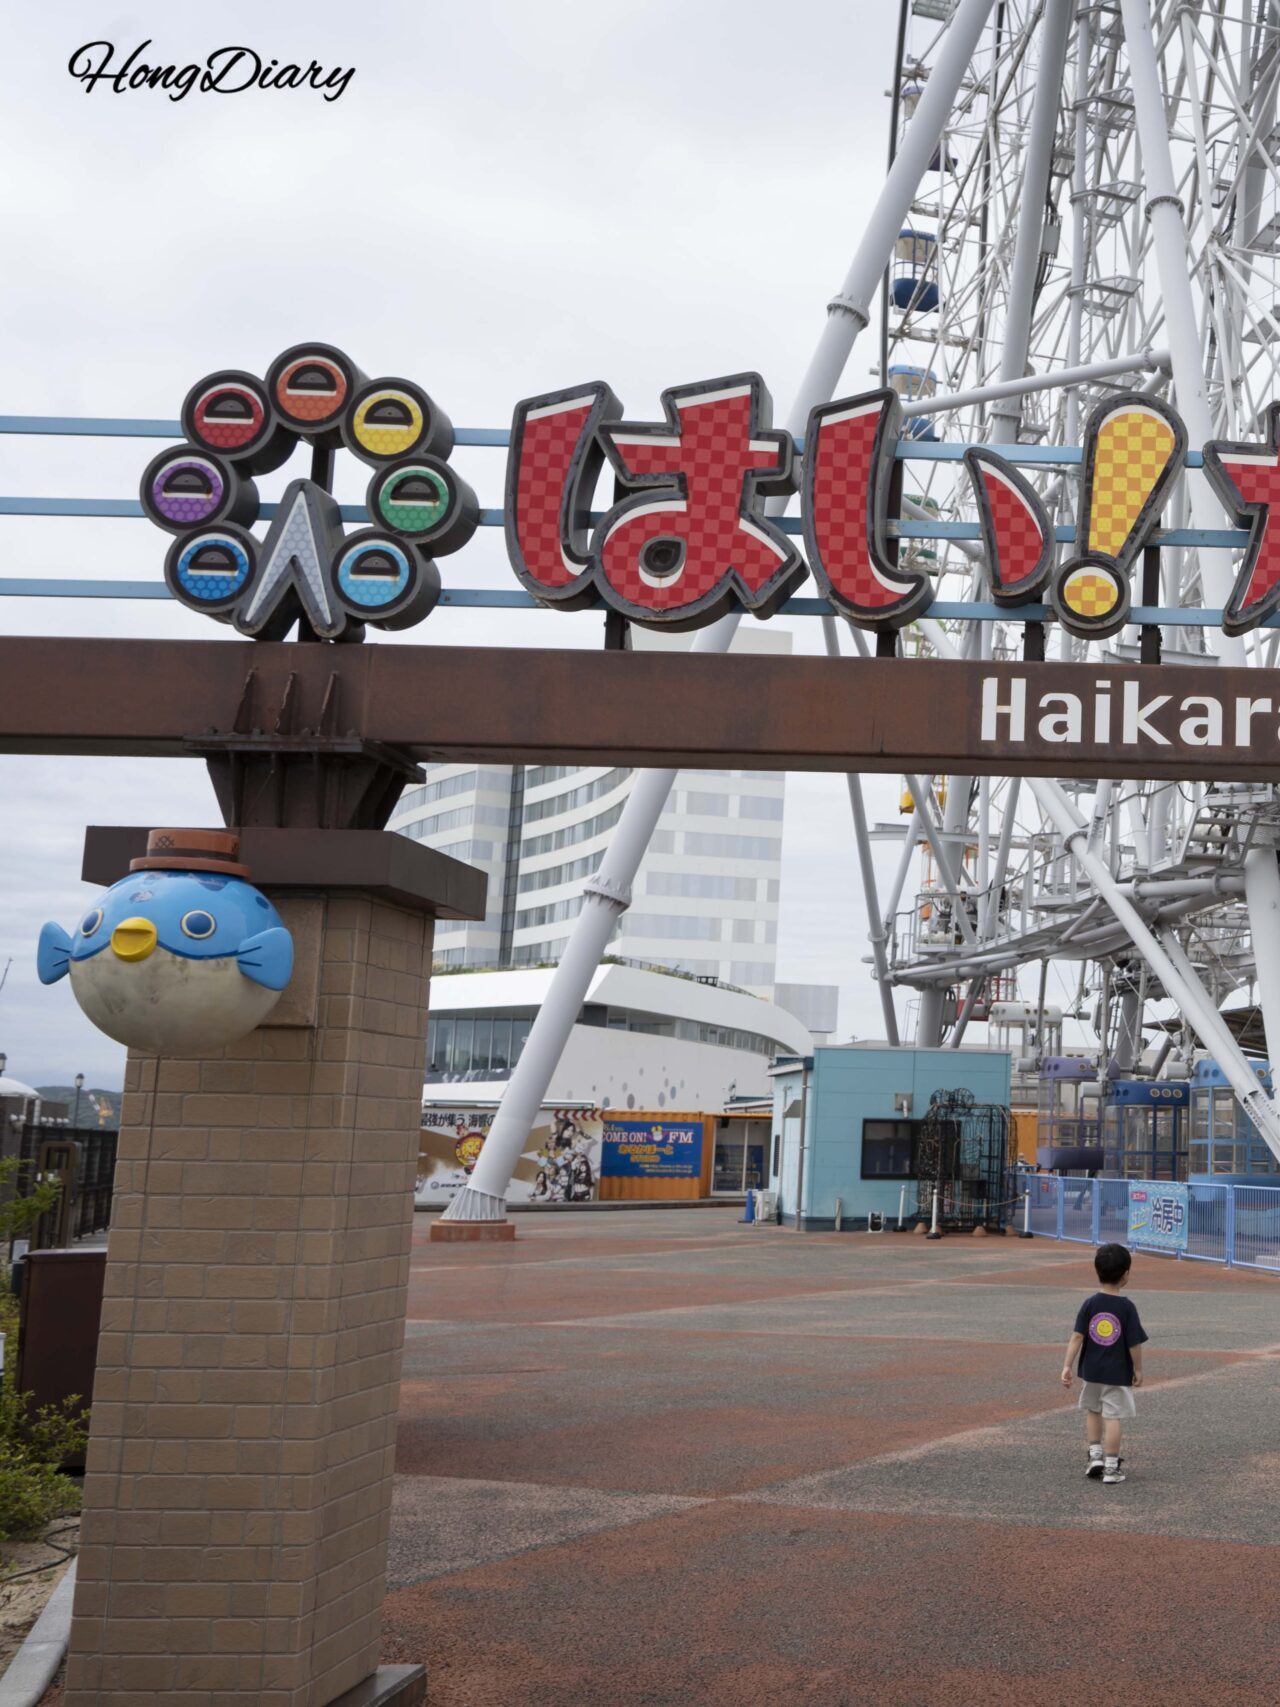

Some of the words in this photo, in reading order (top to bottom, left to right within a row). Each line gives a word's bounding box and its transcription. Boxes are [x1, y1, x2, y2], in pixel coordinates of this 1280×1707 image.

[667, 1131, 694, 1144] FM
[1151, 1197, 1184, 1235] 冷房中
